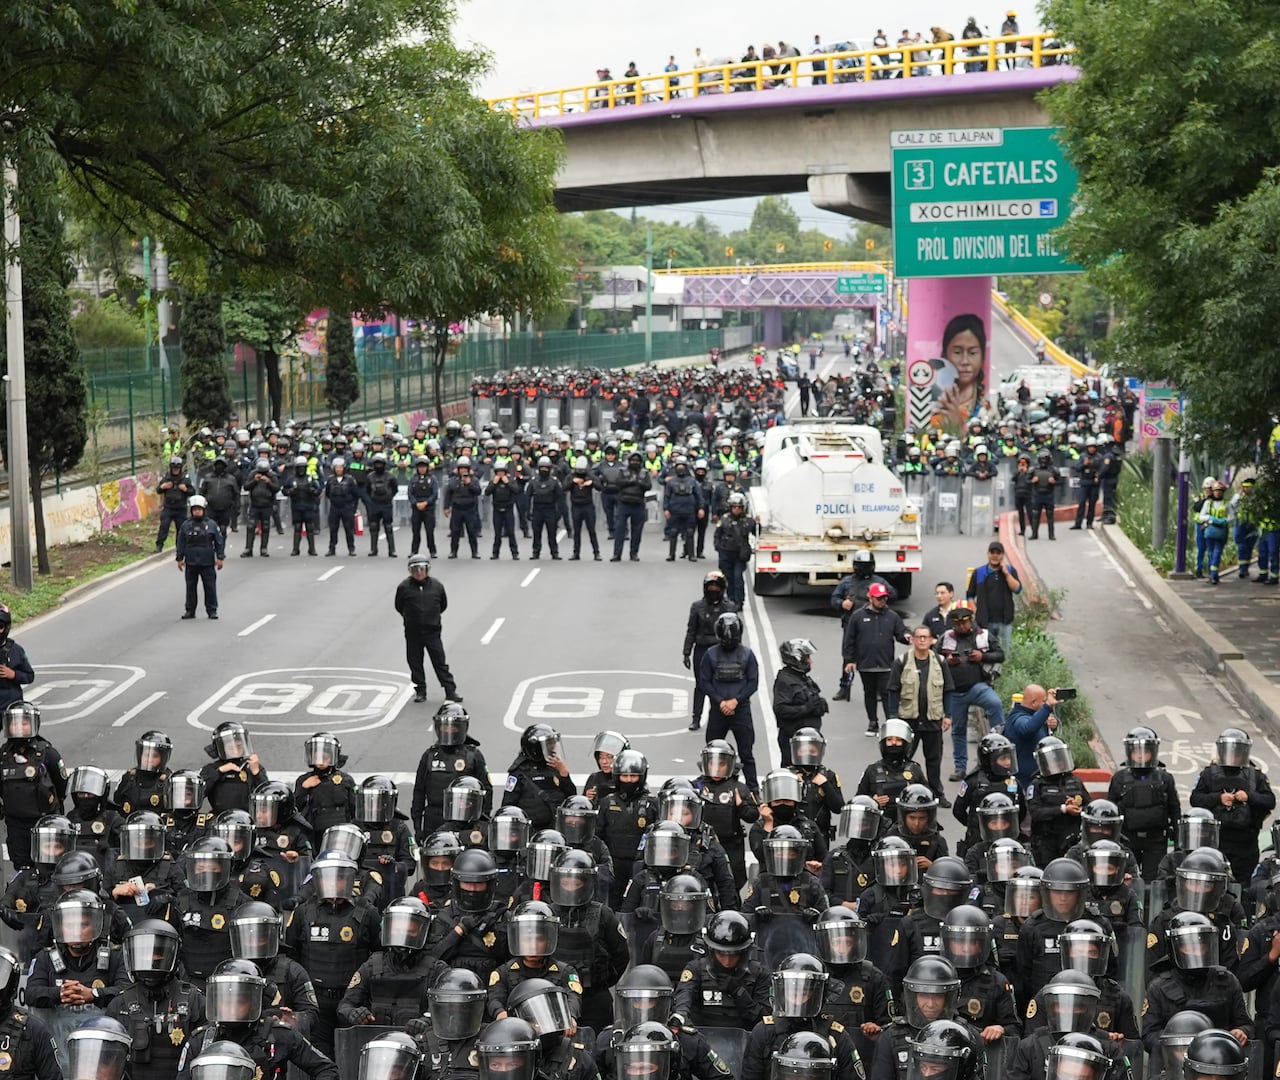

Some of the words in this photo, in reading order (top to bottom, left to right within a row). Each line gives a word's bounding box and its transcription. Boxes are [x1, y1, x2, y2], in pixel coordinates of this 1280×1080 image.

[898, 133, 924, 144] CALZ
[930, 132, 943, 143] DE
[948, 131, 994, 142] TLALPAN
[912, 167, 926, 183] 3
[943, 160, 1058, 186] CAFETALES
[918, 203, 1033, 219] XOCHIMILCO
[917, 237, 949, 261] PROL
[953, 235, 1005, 259] DIVISION
[1009, 234, 1032, 258] DEL
[862, 504, 900, 512] RELAMPAGO
[218, 682, 391, 715] 80
[526, 685, 691, 719] 80
